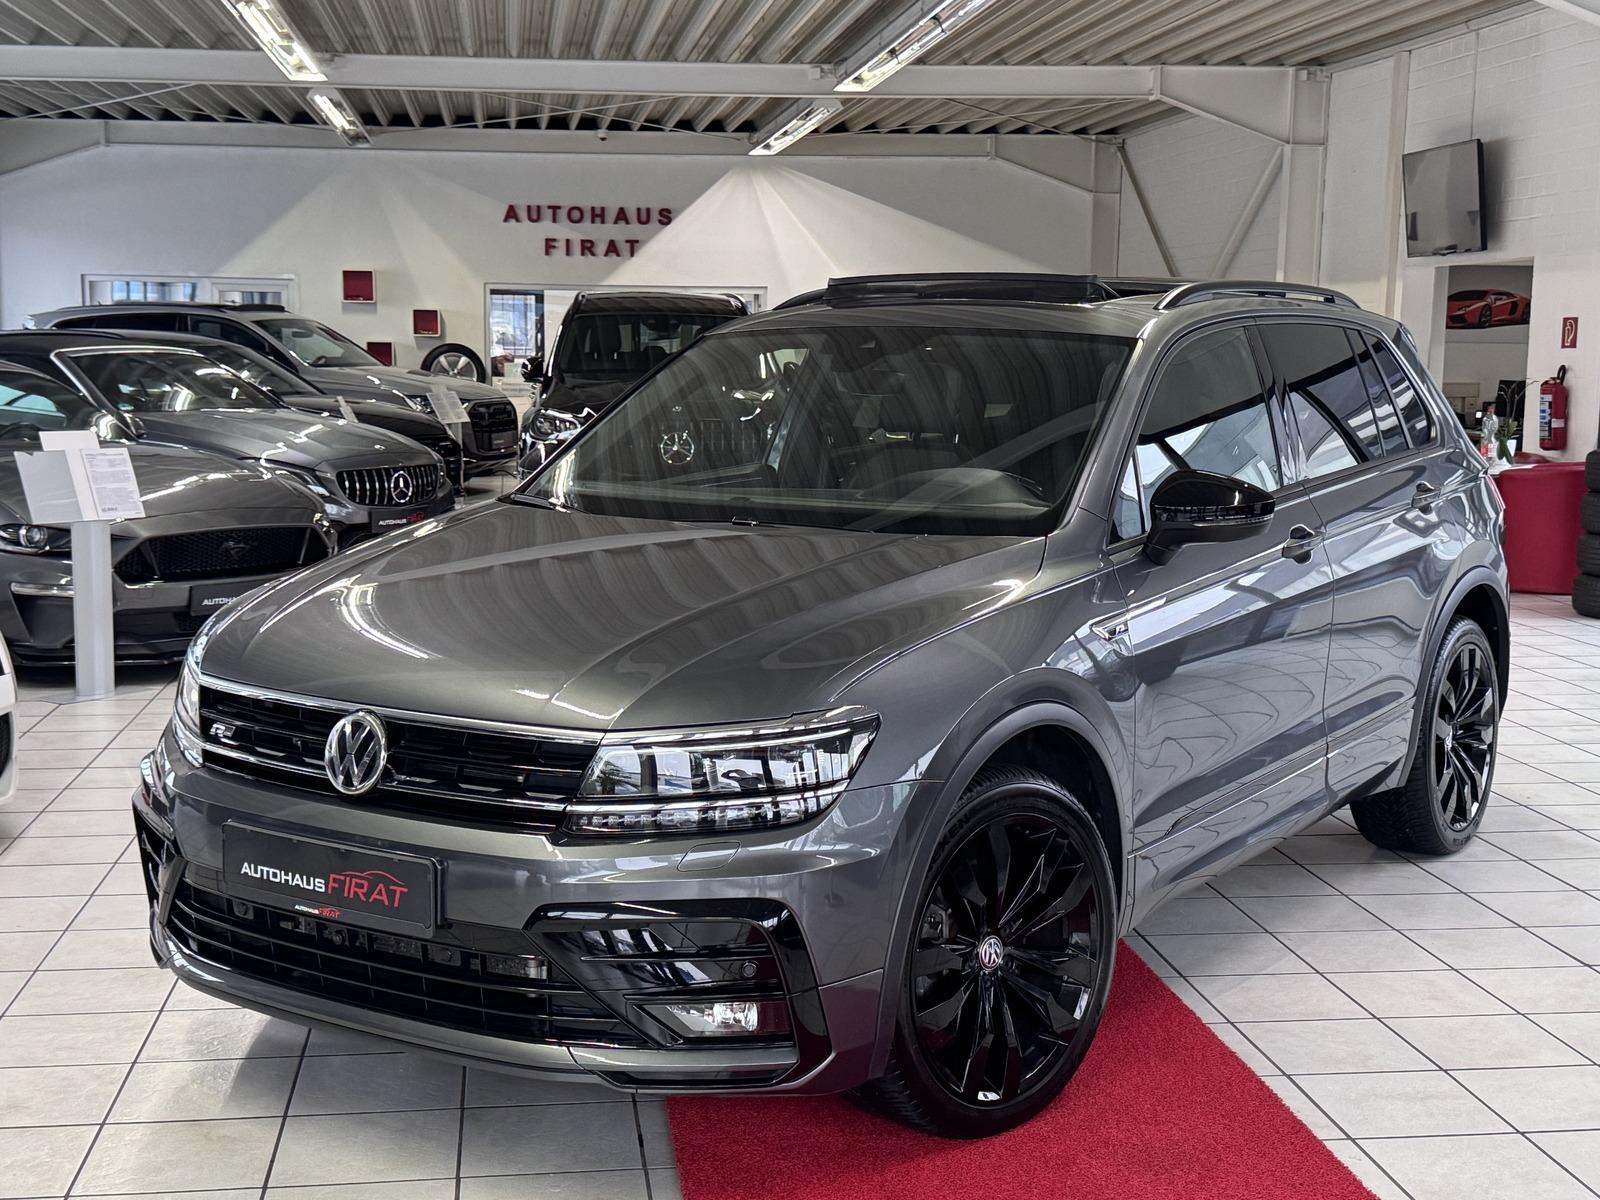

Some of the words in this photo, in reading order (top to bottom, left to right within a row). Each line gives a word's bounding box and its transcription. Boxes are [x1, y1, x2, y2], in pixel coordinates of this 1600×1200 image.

[503, 204, 673, 226] AUTOHAUS
[544, 238, 640, 257] FIRAT
[240, 861, 326, 893] AUTOHAUS
[327, 872, 409, 908] FIRAT
